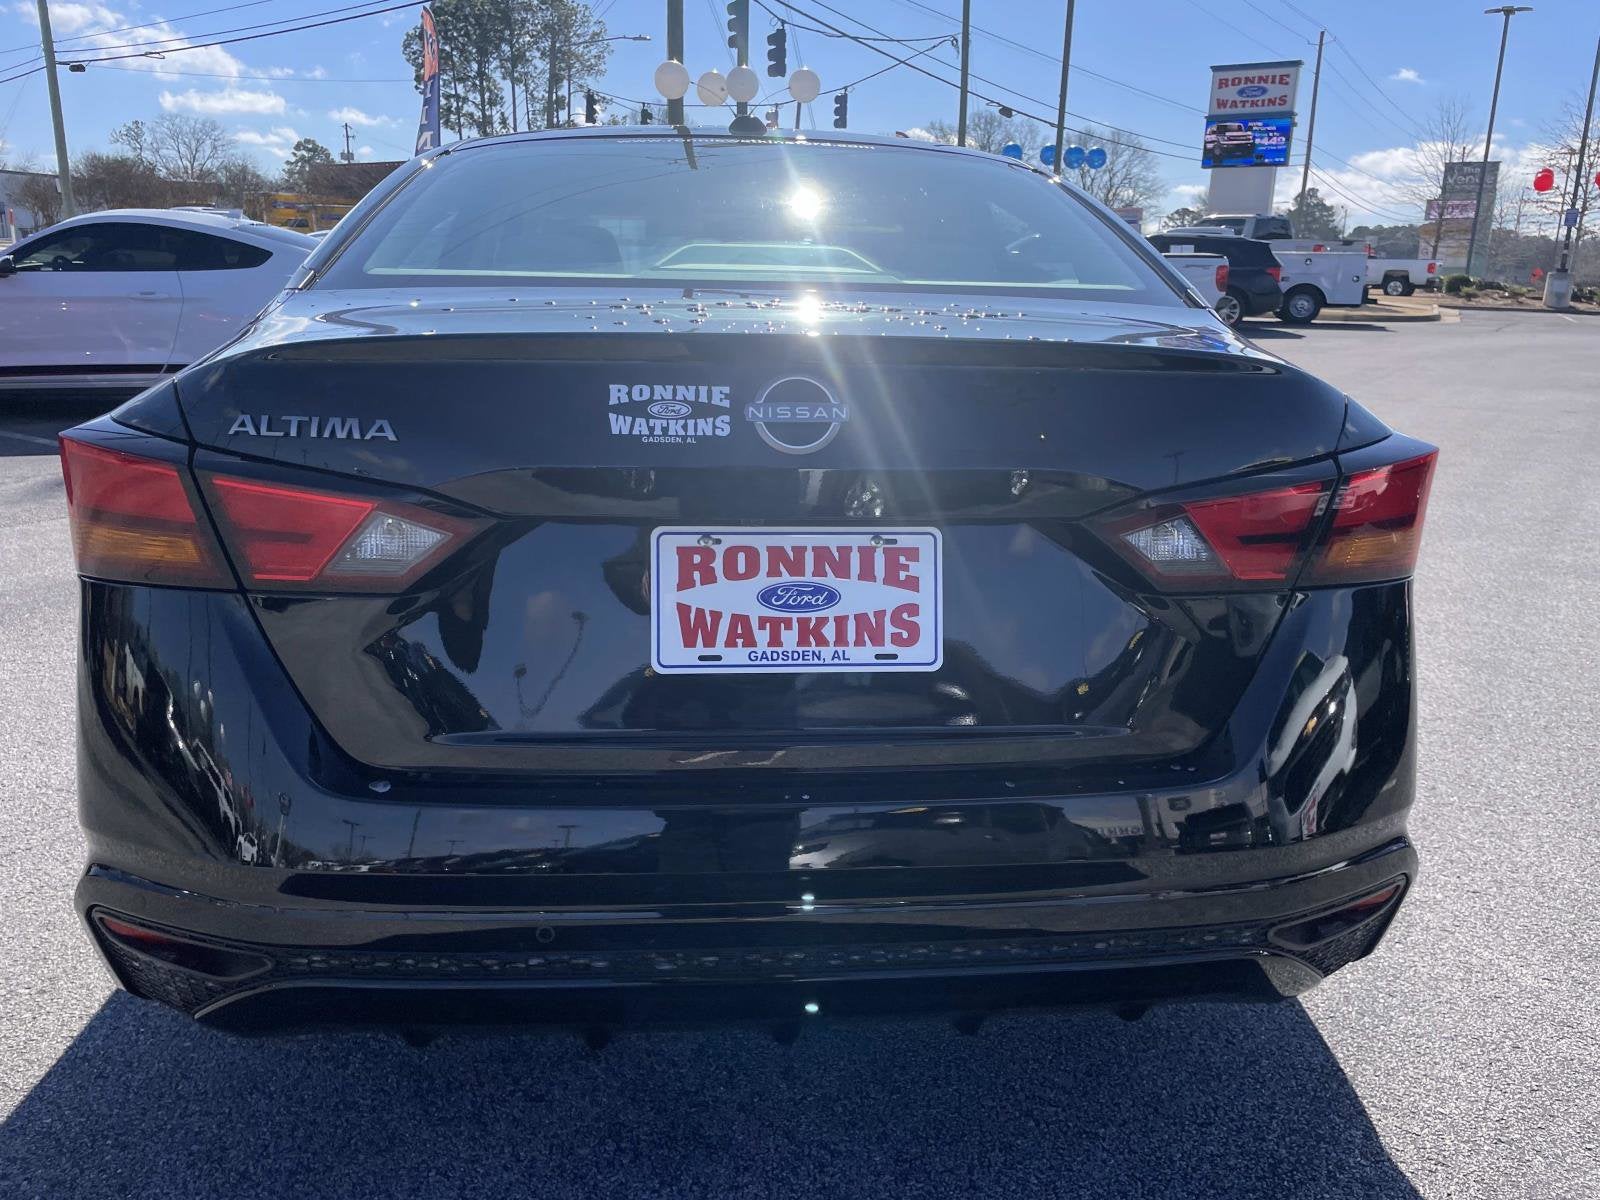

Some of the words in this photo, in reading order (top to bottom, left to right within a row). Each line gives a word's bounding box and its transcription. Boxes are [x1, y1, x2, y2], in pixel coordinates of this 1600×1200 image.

[1217, 74, 1291, 89] RONNIE
[1216, 95, 1288, 109] WATKINS
[608, 384, 730, 408] RONNIE
[656, 404, 683, 415] Ford
[748, 406, 847, 418] NISSAN
[227, 414, 398, 441] ALTIMA
[608, 412, 731, 437] WATKINS
[676, 545, 920, 593] RONNIE
[771, 585, 828, 606] Ford
[676, 602, 921, 649] WATKINS
[748, 650, 826, 663] GADSDEN,
[831, 650, 850, 661] AL
